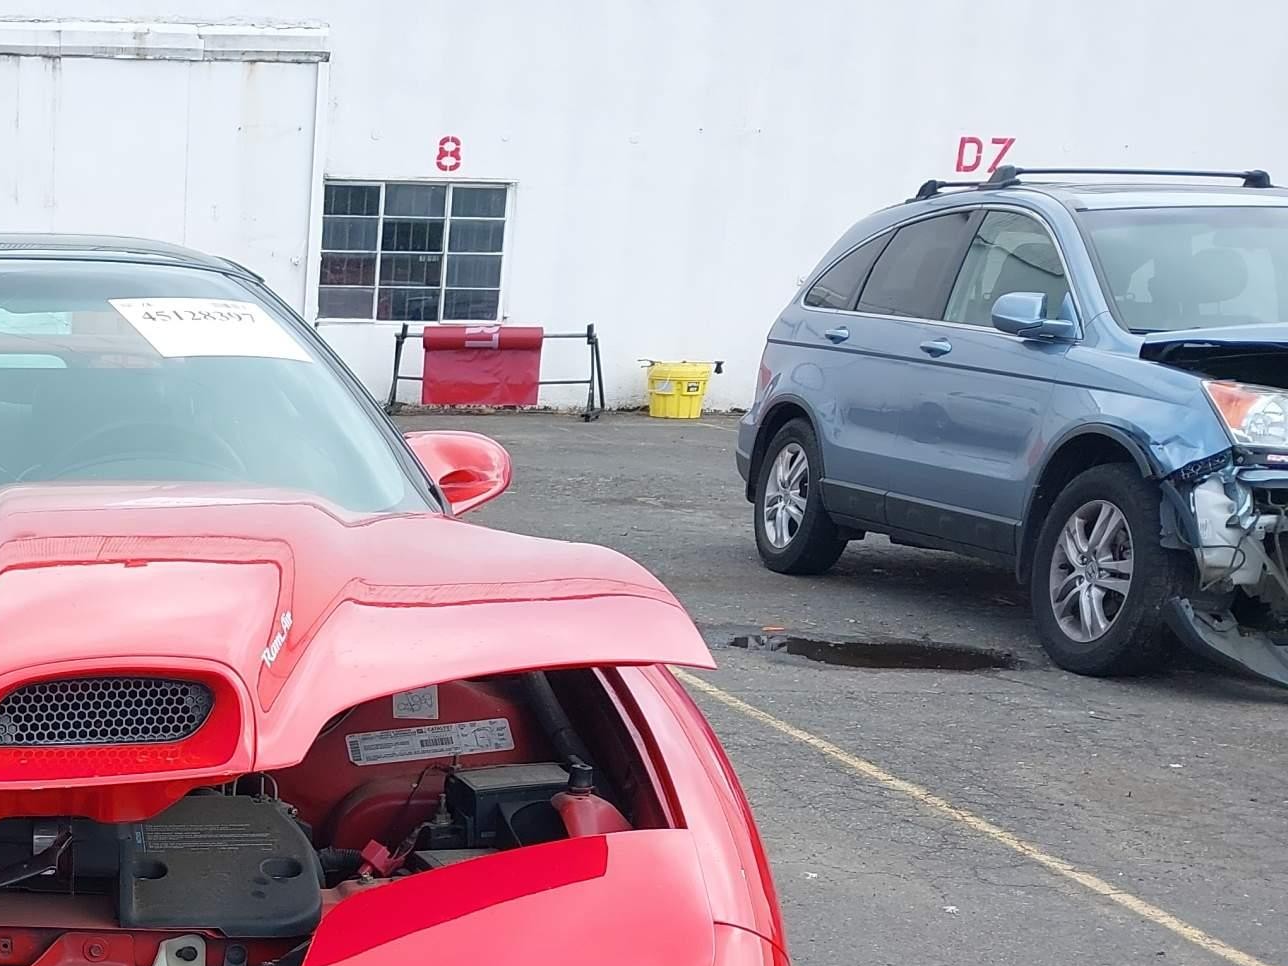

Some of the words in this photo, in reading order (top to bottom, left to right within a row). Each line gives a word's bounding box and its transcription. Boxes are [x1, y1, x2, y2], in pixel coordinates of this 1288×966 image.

[436, 135, 461, 171] 8
[956, 136, 1016, 173] D7
[142, 310, 256, 323] 45128397
